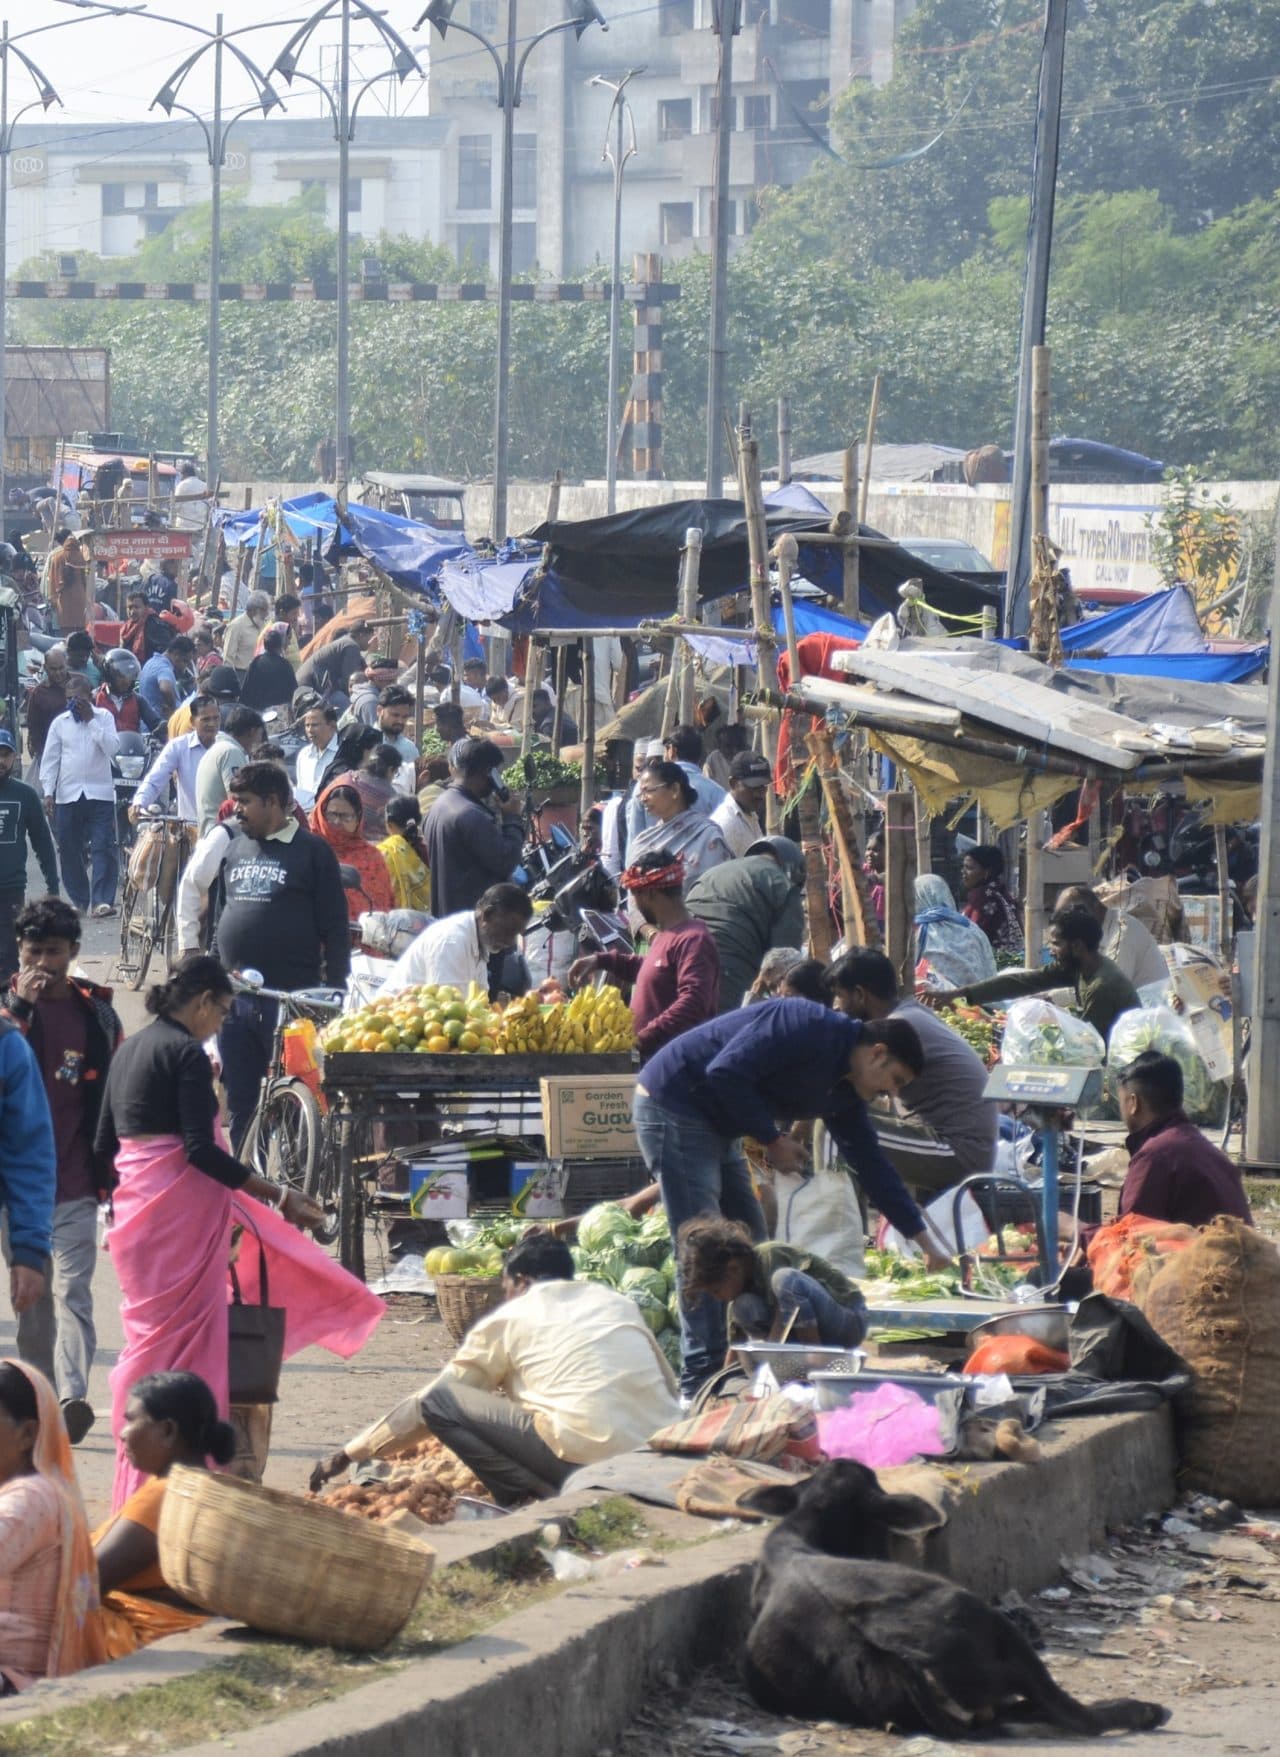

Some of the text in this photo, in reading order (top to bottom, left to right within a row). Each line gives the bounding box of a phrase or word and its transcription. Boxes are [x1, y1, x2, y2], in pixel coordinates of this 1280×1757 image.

[1079, 529, 1106, 560] TYPES
[1095, 564, 1112, 581] CALL
[229, 865, 288, 885] EXERCISE
[585, 1092, 623, 1101] Garden
[600, 1101, 629, 1110] Fresh
